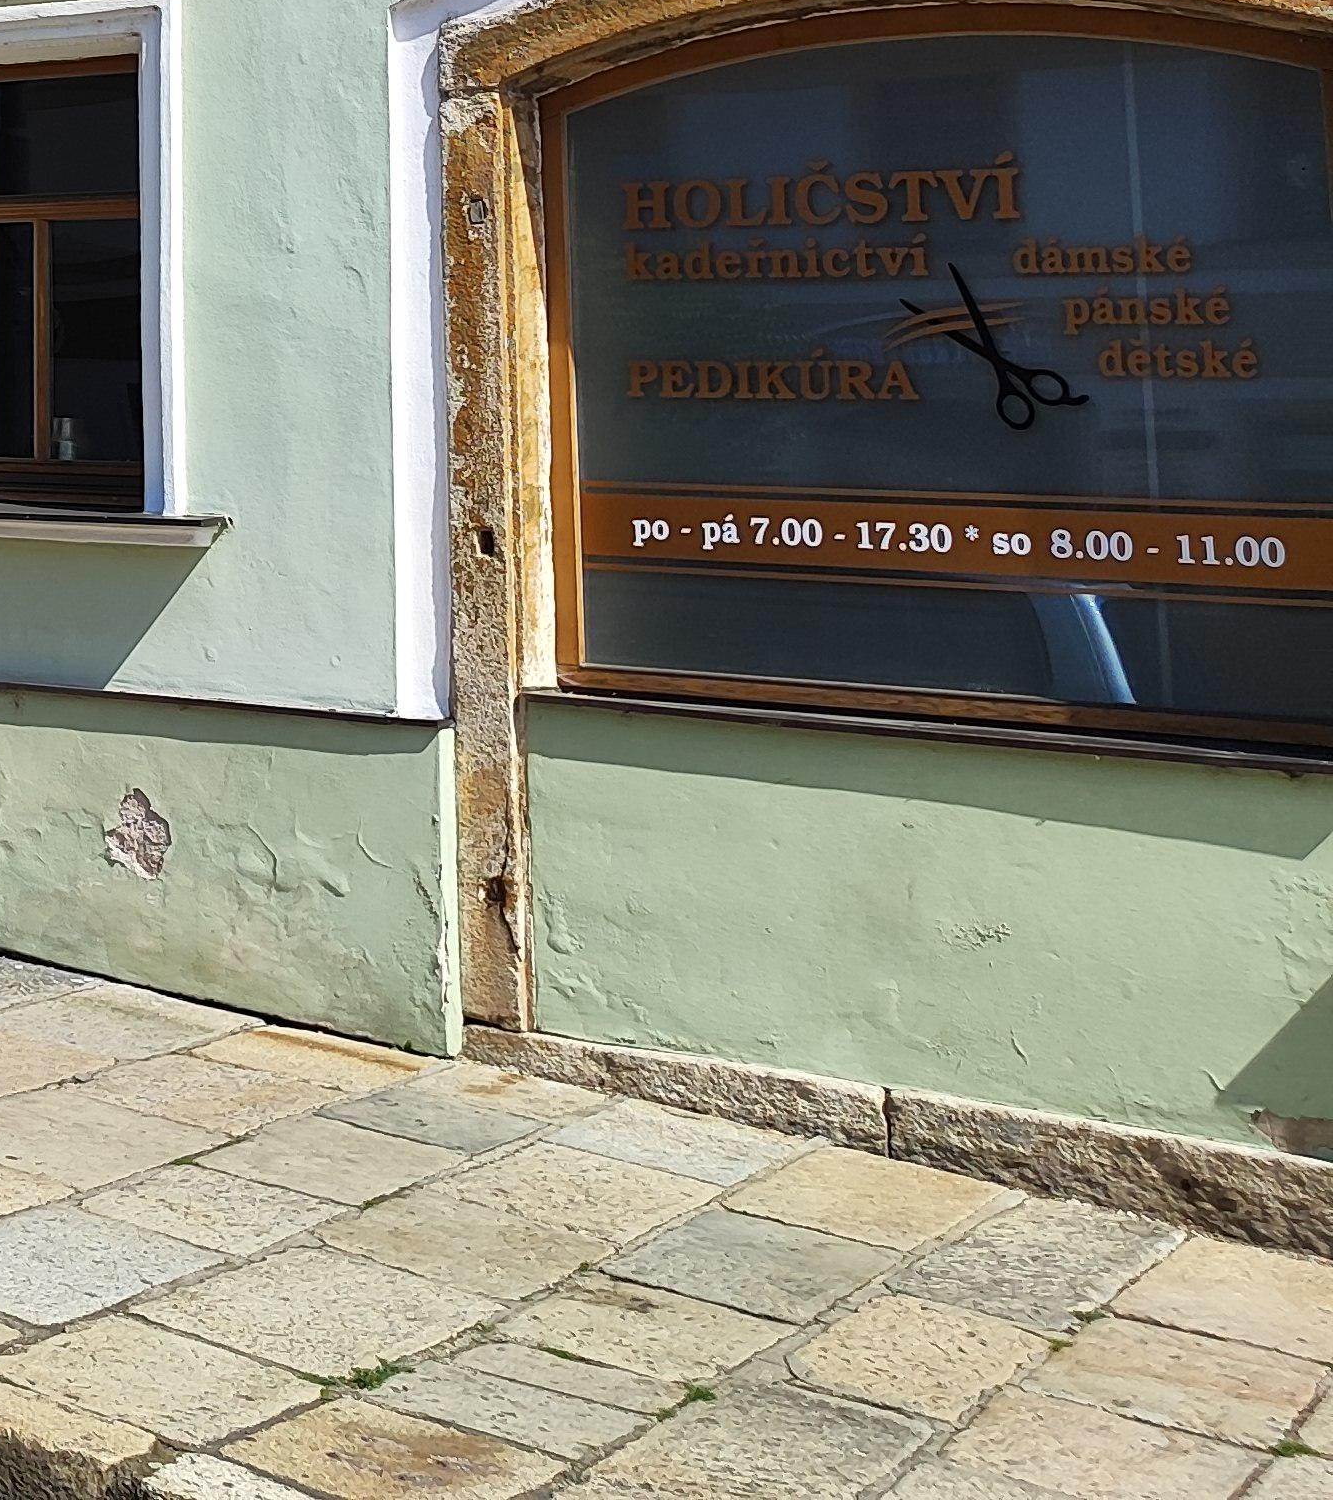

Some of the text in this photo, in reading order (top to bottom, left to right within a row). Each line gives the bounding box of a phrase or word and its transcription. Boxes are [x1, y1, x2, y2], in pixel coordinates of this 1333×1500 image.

[622, 154, 1021, 230] HOLIČSTVÍ
[1013, 235, 1193, 276] dámské
[1062, 285, 1232, 335] pánské
[627, 348, 919, 401] PEDIKÚRA
[1097, 339, 1259, 380] dětské
[632, 517, 670, 546] po
[702, 513, 740, 550] pá
[749, 518, 823, 547] 7.00
[856, 521, 953, 553] 17.30
[992, 533, 1032, 556] so
[1050, 530, 1133, 563] 8.00
[1176, 534, 1286, 568] 11.00
